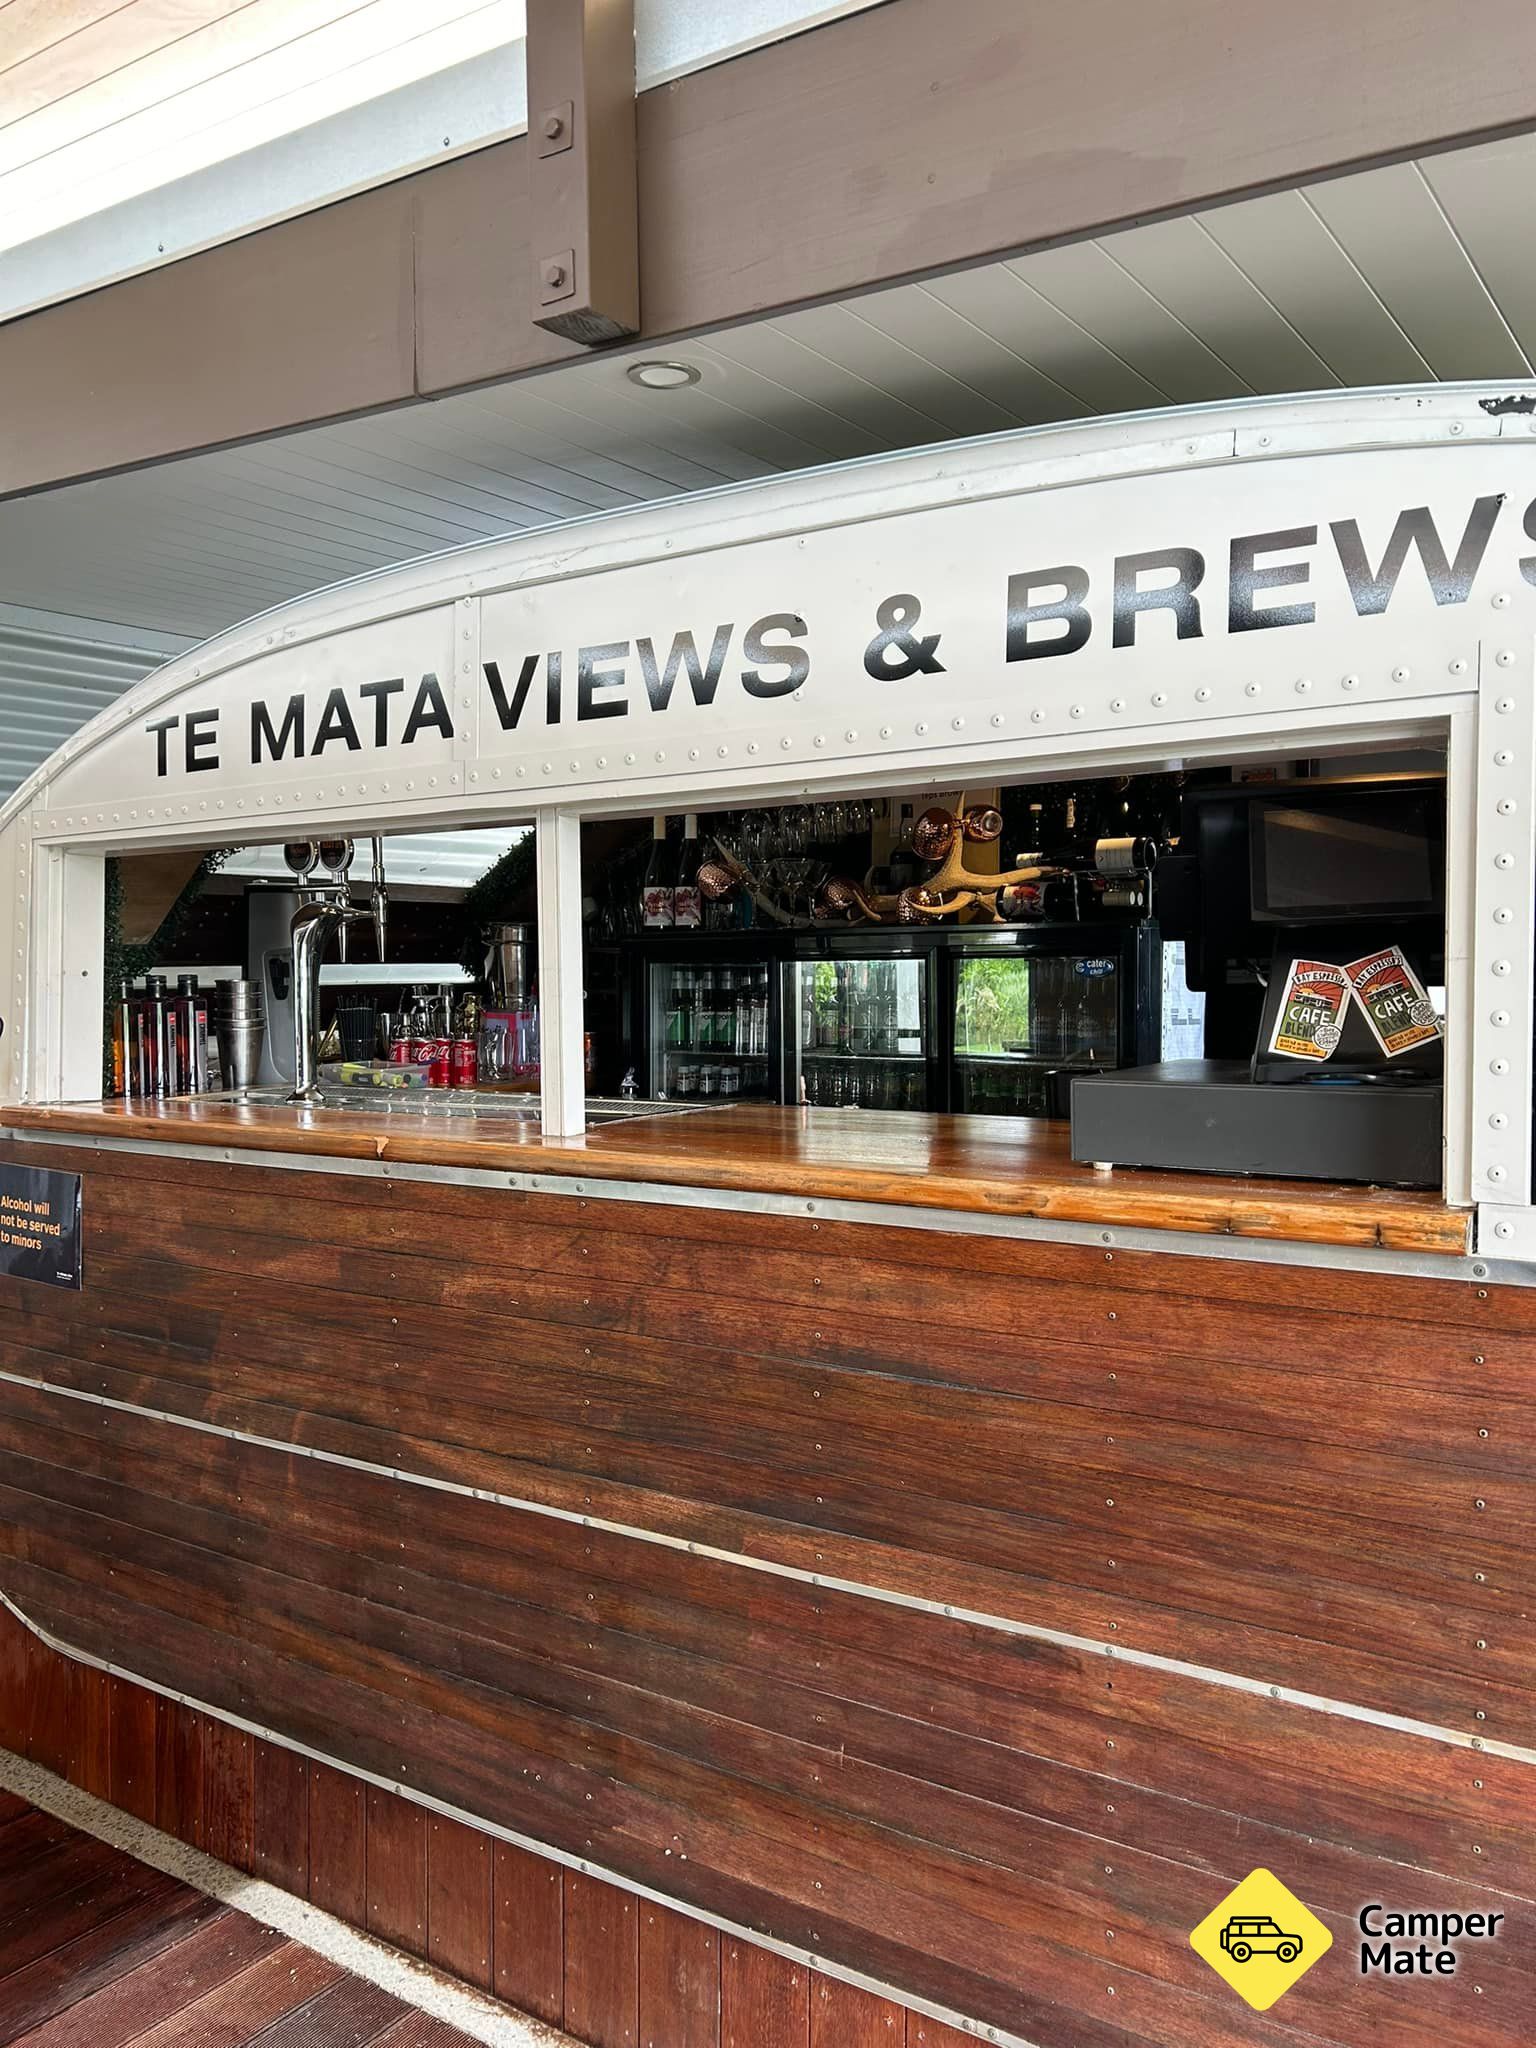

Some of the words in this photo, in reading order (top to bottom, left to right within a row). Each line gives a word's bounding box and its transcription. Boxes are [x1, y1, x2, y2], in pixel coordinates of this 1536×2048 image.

[146, 708, 219, 776] TE
[251, 672, 455, 764] MATA
[482, 613, 810, 730] VIEWS
[863, 593, 947, 682] &
[1006, 492, 1536, 663] BREW
[1374, 992, 1414, 1019] CAFE
[1290, 1006, 1332, 1026] CAFE
[1, 1196, 32, 1213] Alcohol
[34, 1202, 50, 1216] will
[0, 1215, 15, 1227] not
[17, 1216, 28, 1229] be
[29, 1220, 60, 1236] served
[0, 1231, 10, 1243] to
[11, 1233, 42, 1250] minors
